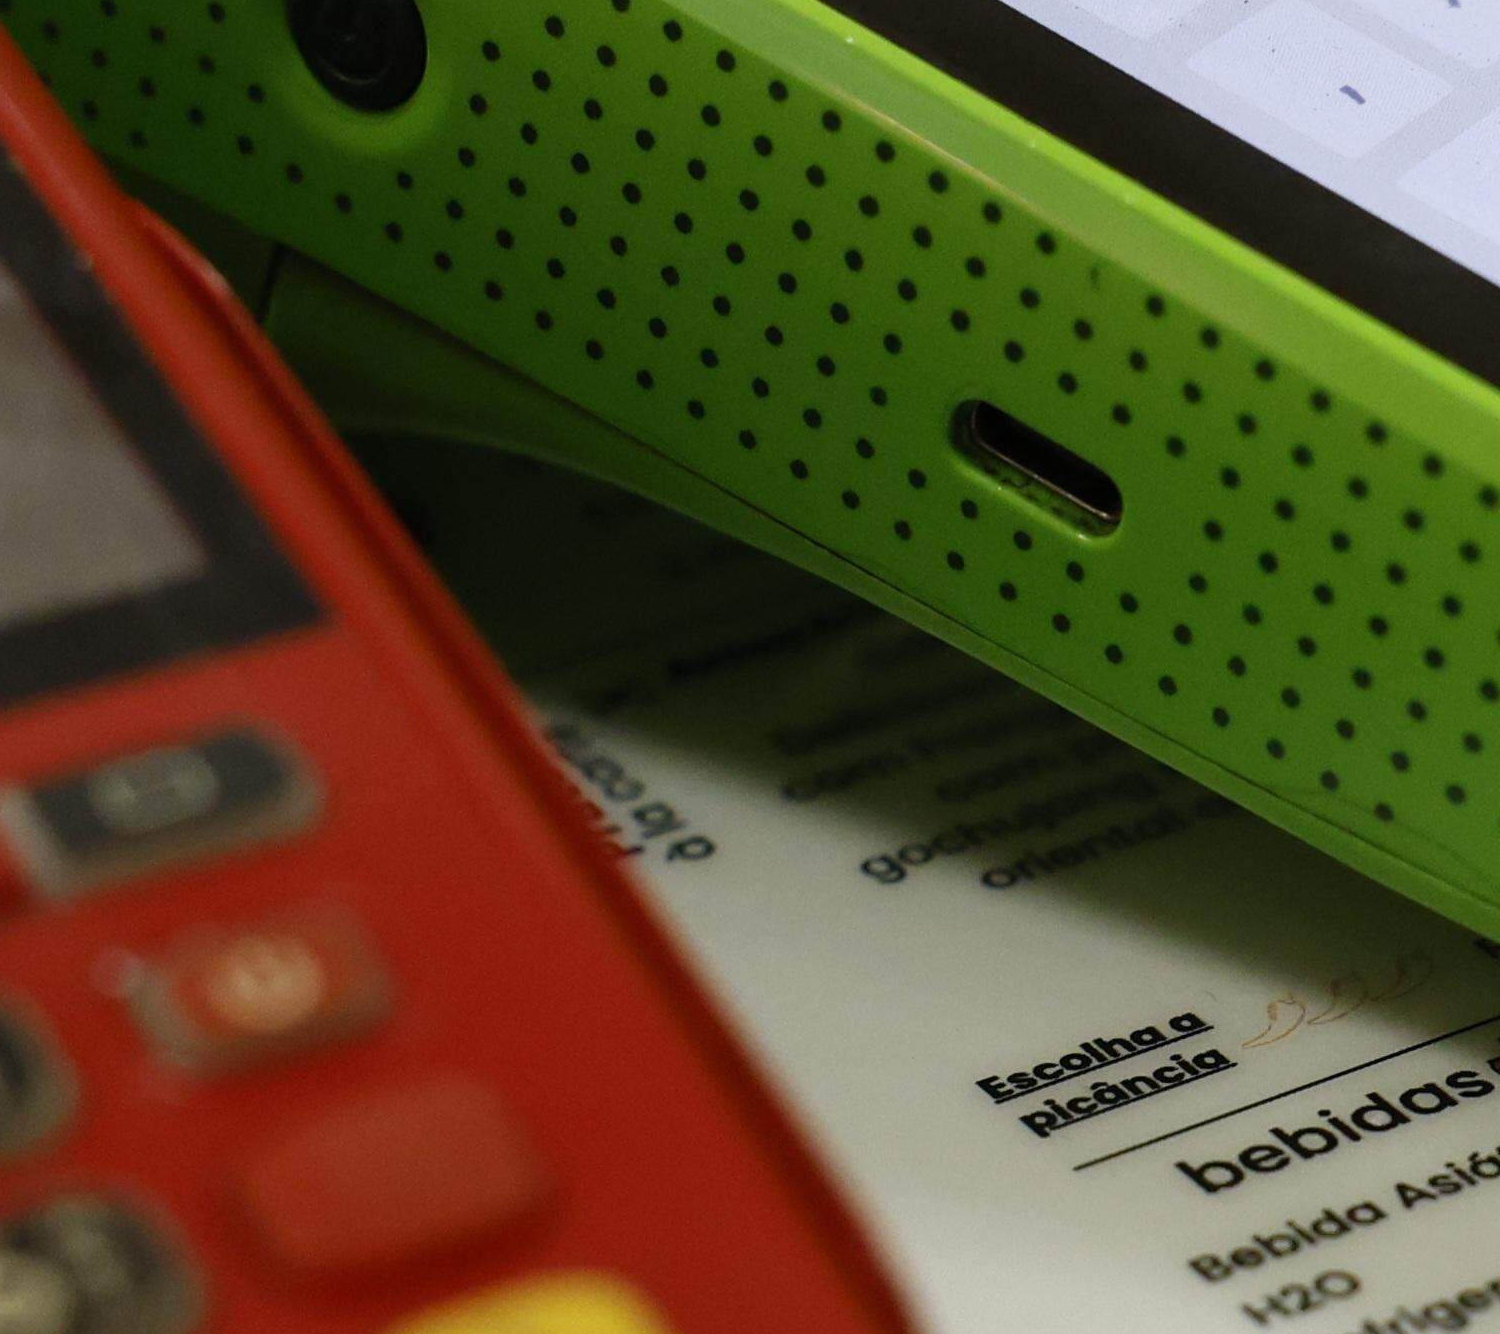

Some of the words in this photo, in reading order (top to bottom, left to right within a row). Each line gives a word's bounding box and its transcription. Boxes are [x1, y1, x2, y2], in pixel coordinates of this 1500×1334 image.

[976, 1022, 1168, 1104] Escolha
[1168, 1011, 1214, 1035] a
[1018, 1048, 1238, 1139] picância
[1176, 1069, 1495, 1193] bebidas
[1189, 1202, 1387, 1282] Bebida
[1241, 1270, 1361, 1328] H2O
